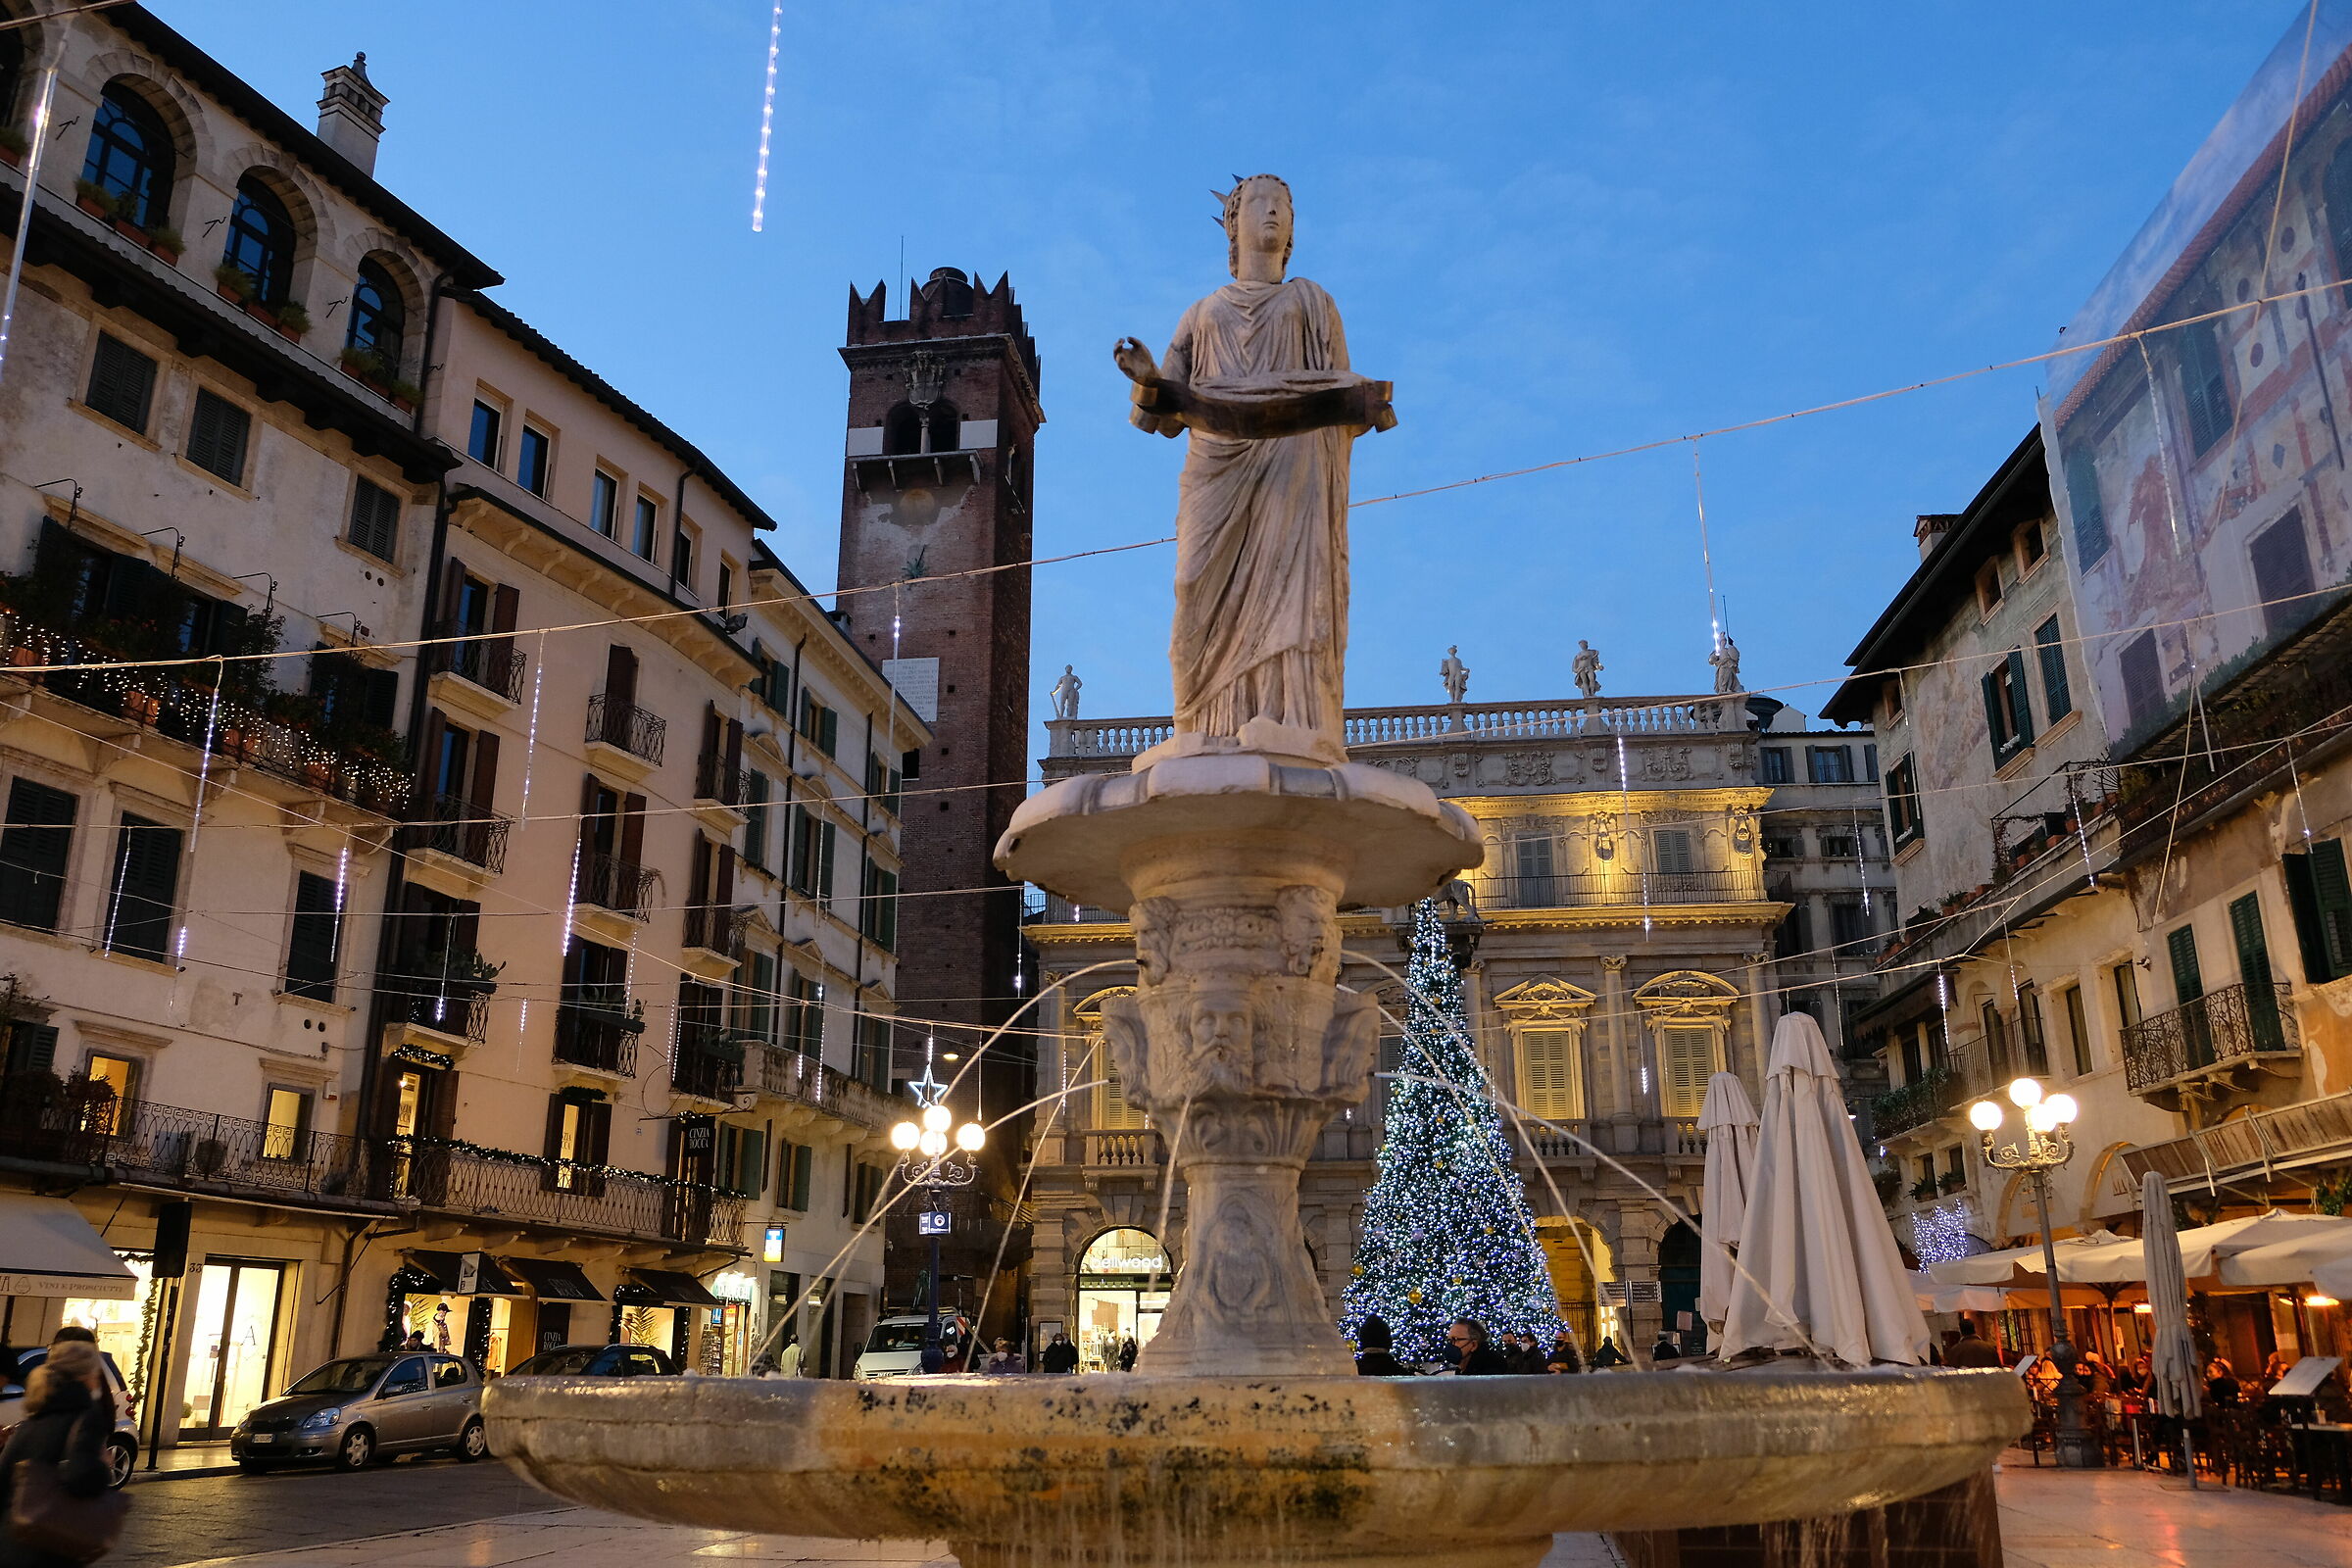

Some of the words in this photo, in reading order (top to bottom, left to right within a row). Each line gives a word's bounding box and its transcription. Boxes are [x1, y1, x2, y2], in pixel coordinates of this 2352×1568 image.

[689, 1127, 710, 1138] CINZIA
[689, 1138, 709, 1149] ROCCA
[1090, 1254, 1162, 1269] bellwood
[189, 1262, 202, 1273] 33
[39, 1281, 59, 1290] VINI
[69, 1283, 123, 1293] PROSCIUTTI
[543, 1331, 562, 1342] CINZIA
